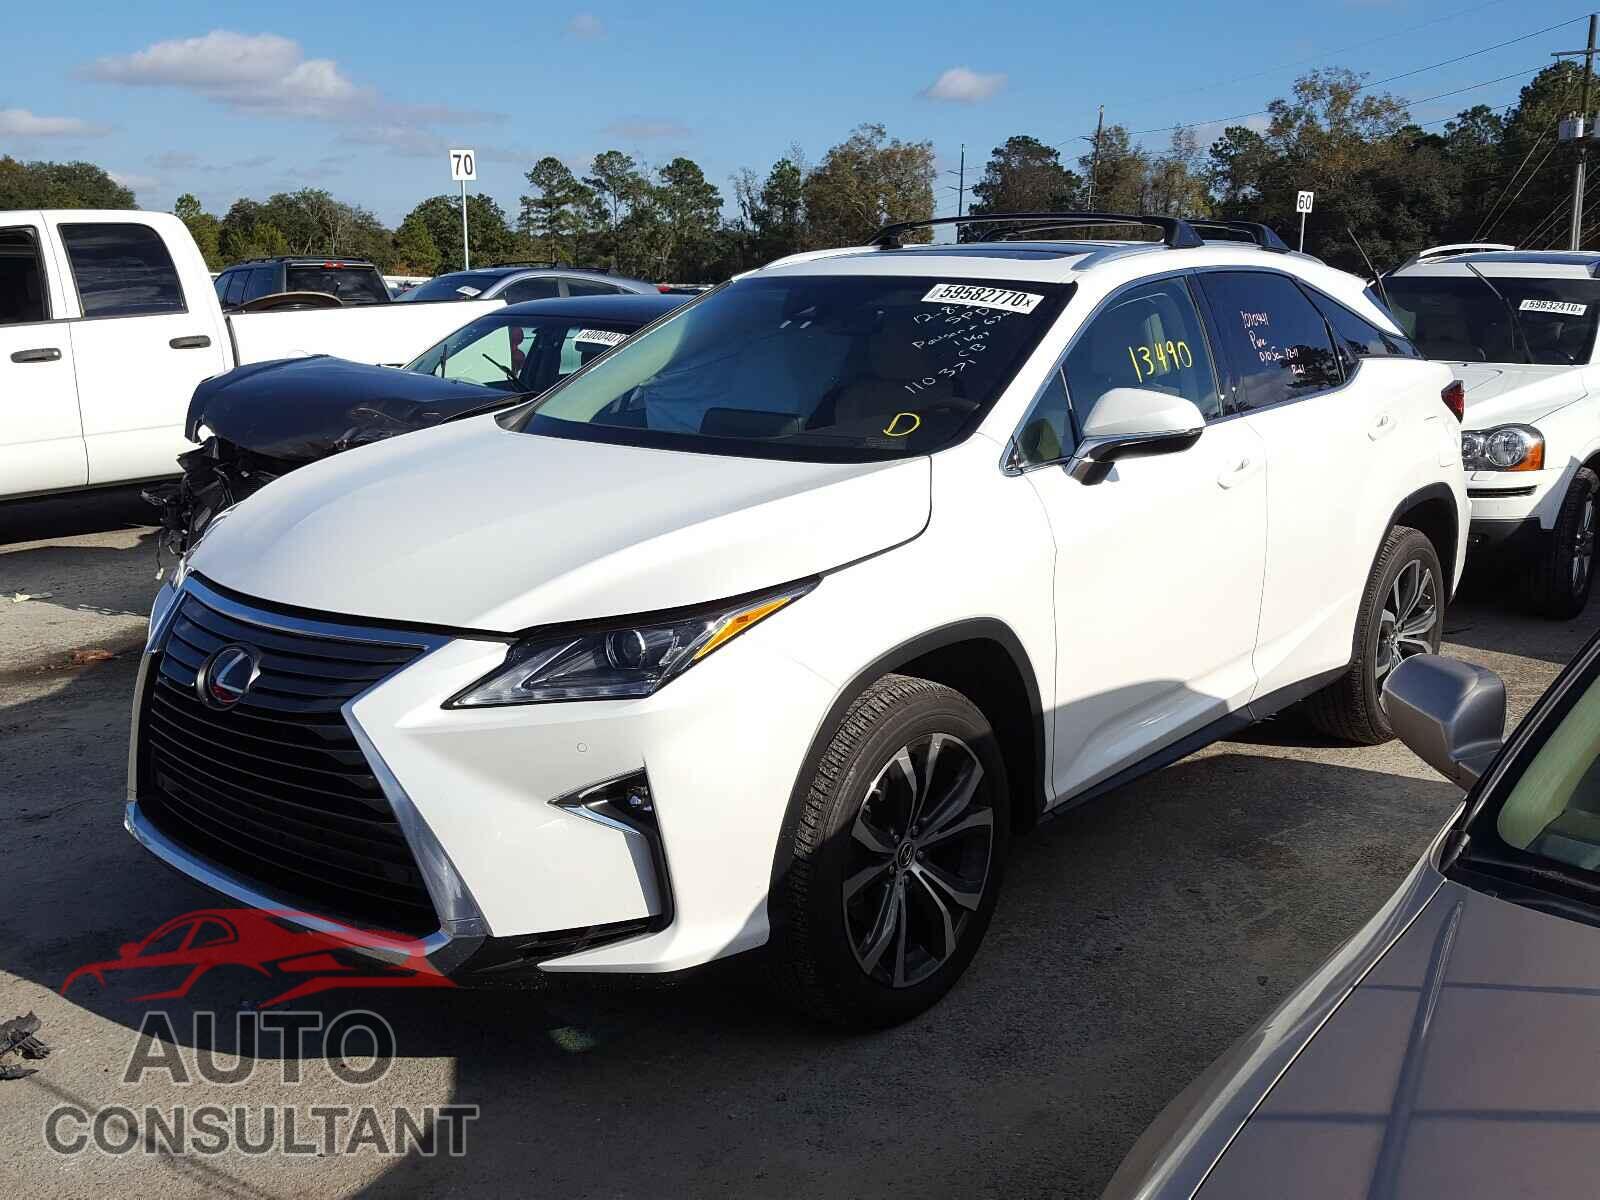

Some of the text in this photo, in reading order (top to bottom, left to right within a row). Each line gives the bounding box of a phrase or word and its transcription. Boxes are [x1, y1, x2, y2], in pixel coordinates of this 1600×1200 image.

[452, 153, 474, 176] 70
[1298, 194, 1312, 210] 60
[1128, 340, 1192, 384] 13490
[883, 412, 920, 437] D
